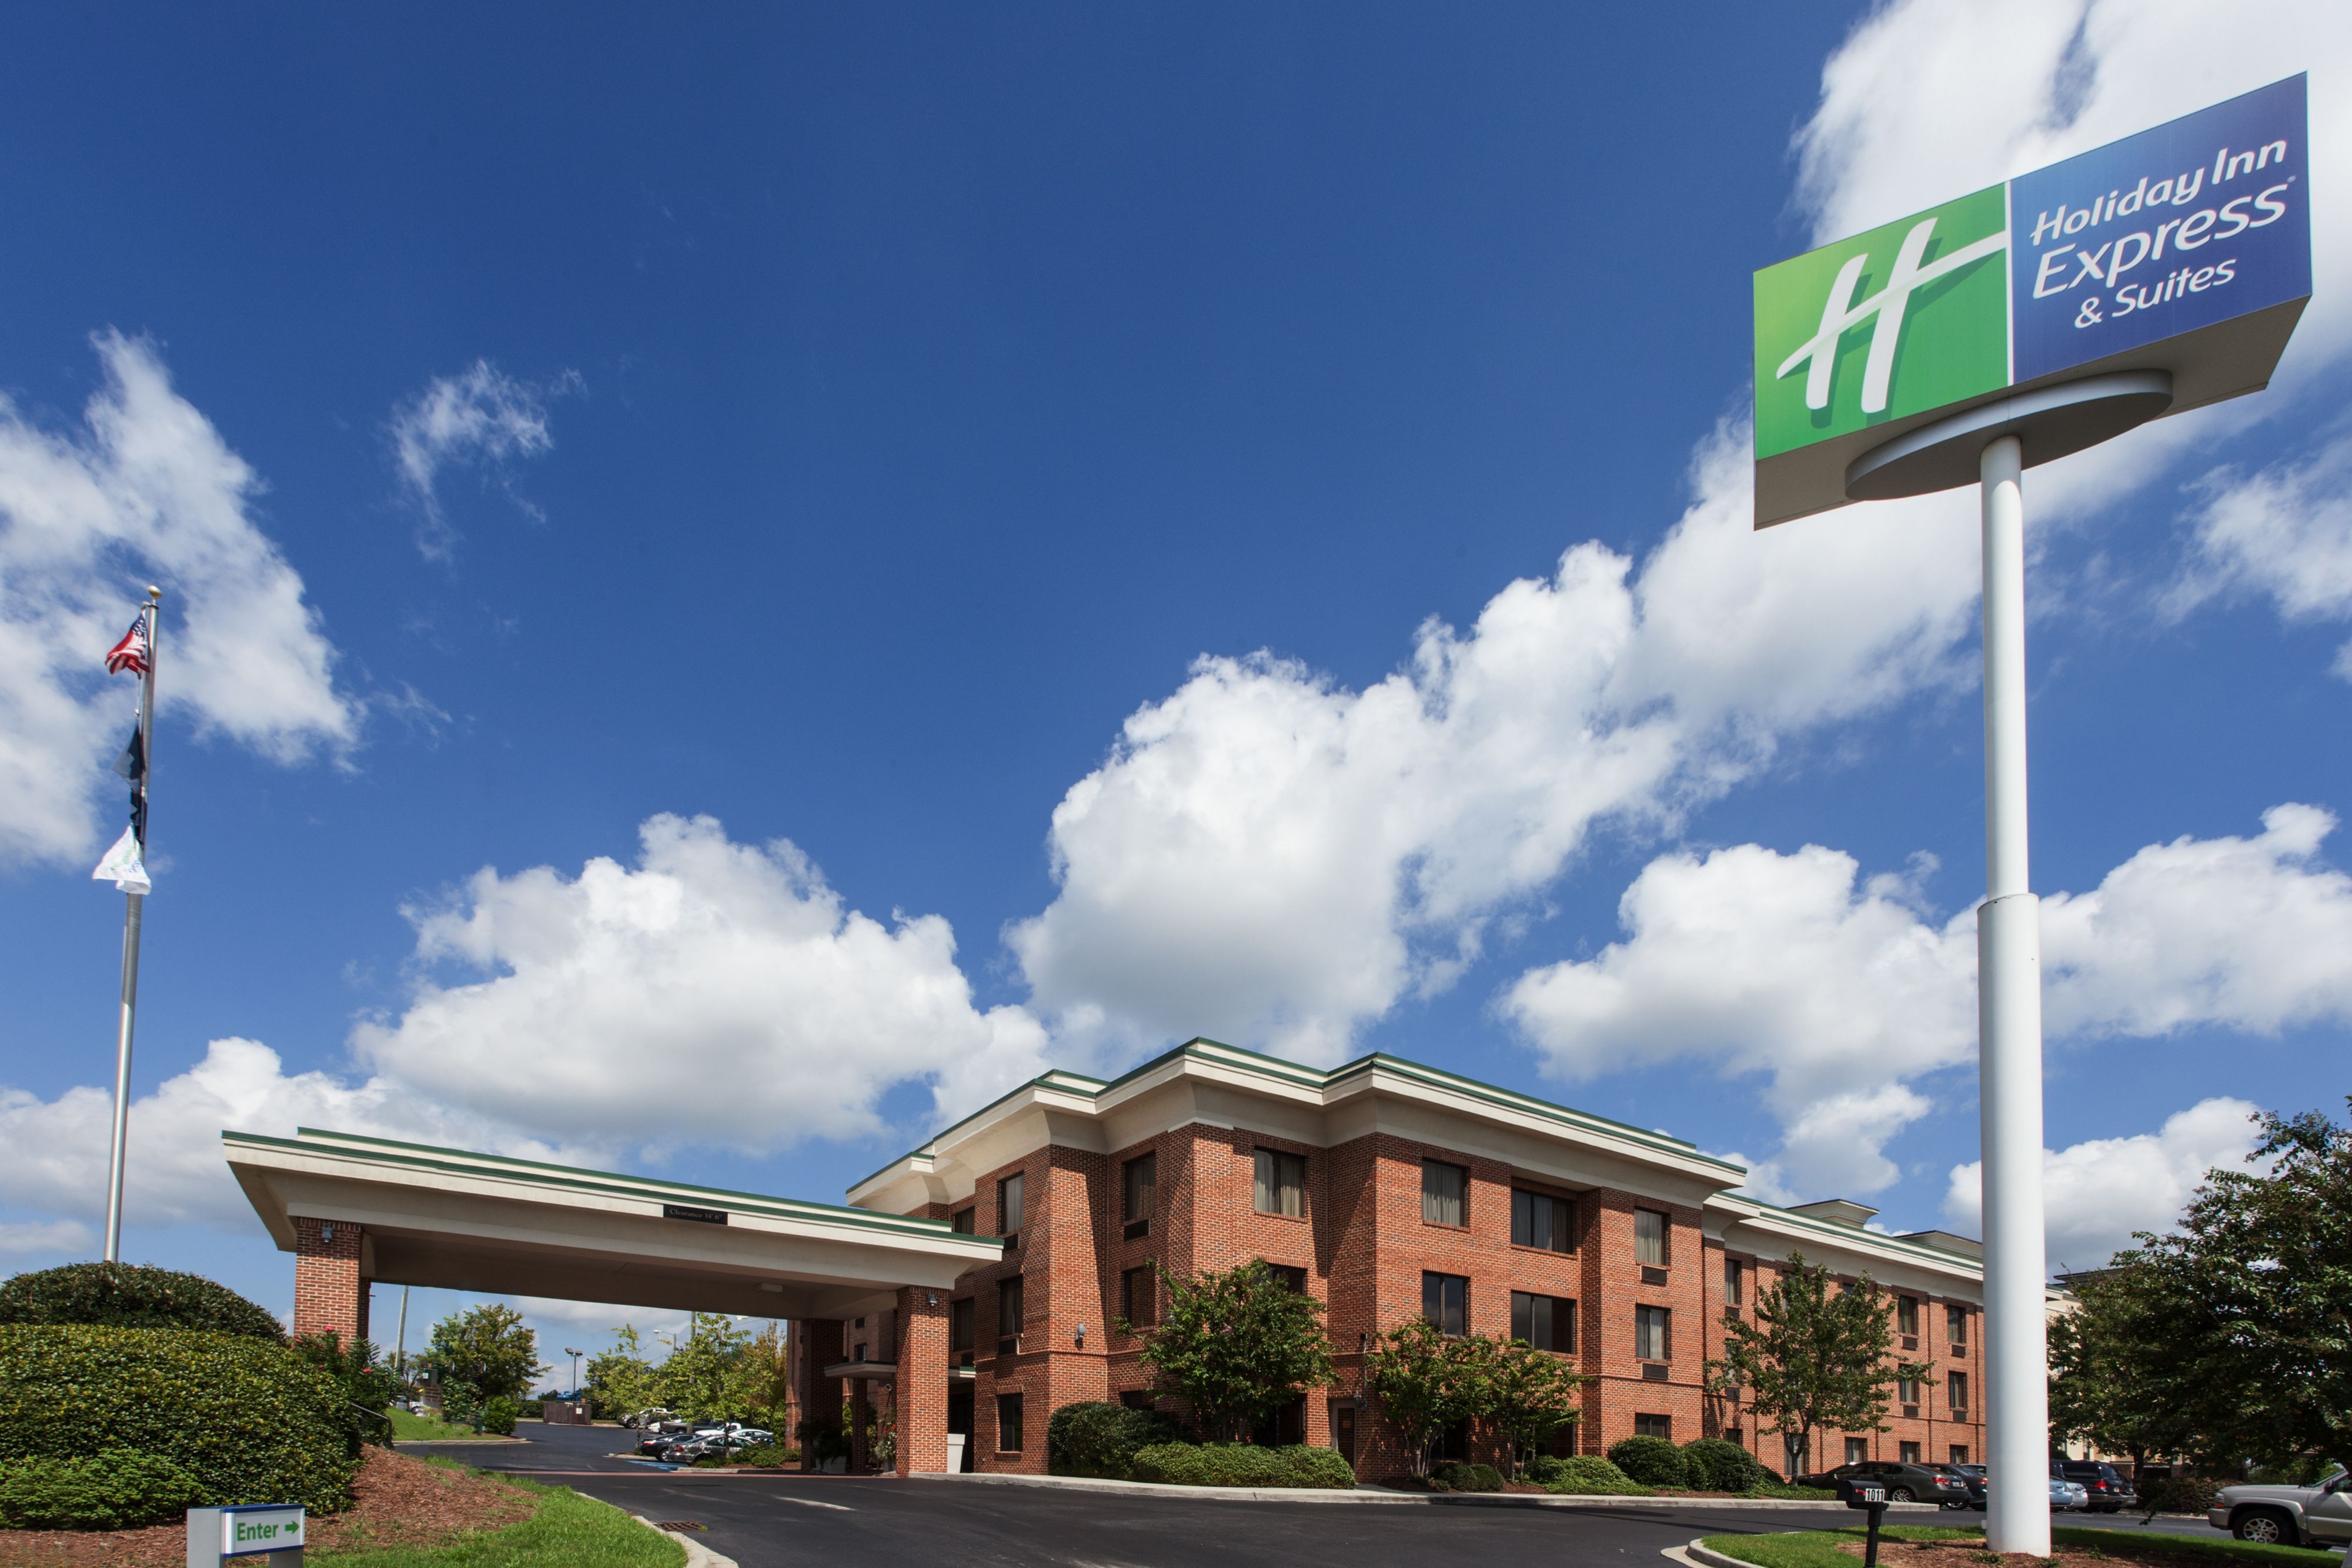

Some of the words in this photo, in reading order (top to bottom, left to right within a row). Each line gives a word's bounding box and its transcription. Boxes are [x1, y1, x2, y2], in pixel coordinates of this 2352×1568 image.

[2030, 168, 2206, 246] Holiday
[2211, 139, 2287, 185] Inn
[2033, 183, 2288, 300] Express
[2074, 297, 2103, 329] &
[2112, 259, 2237, 317] Suites
[670, 1208, 703, 1218] Clearance
[1867, 1489, 1884, 1502] 1011
[237, 1522, 279, 1542] Enter
